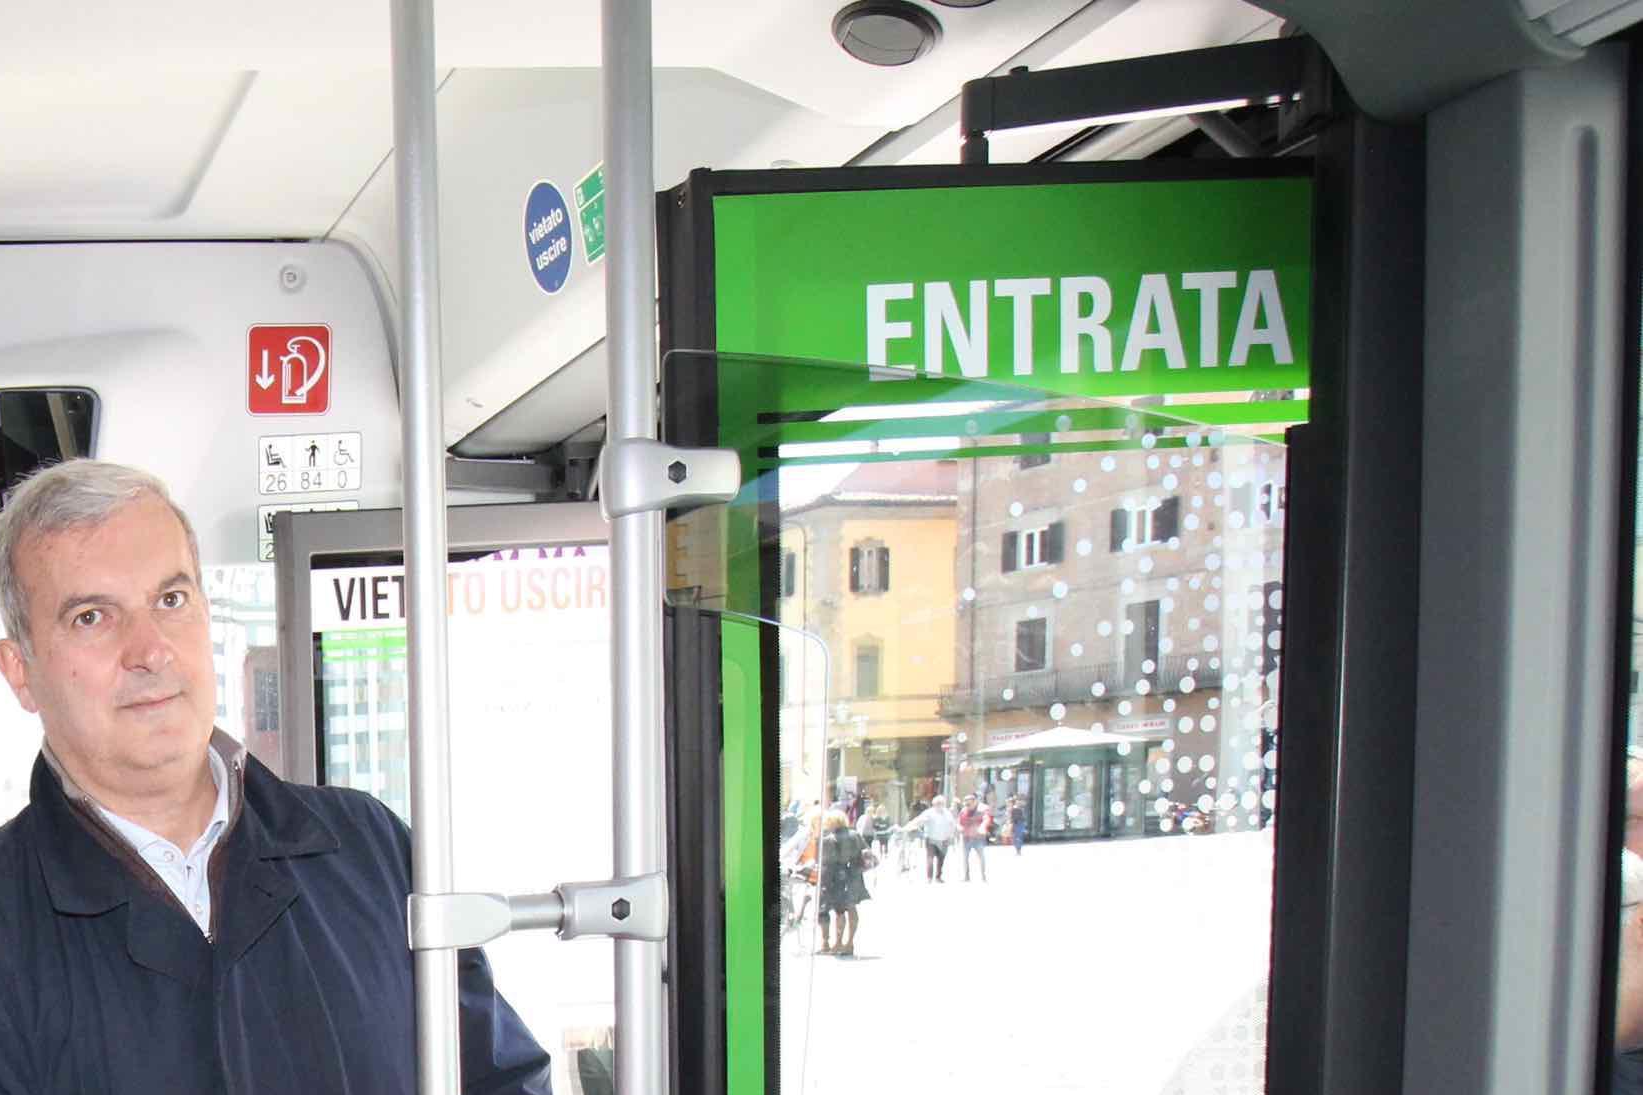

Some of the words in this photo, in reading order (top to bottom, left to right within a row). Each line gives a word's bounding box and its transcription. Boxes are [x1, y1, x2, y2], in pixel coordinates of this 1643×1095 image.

[528, 207, 563, 245] vietato
[535, 237, 568, 271] uscire
[865, 269, 1294, 382] ENTRATA
[265, 473, 287, 492] 26
[300, 471, 322, 490] 84
[337, 470, 348, 488] 0
[333, 571, 487, 622] VIETTO
[500, 565, 606, 614] USCIR
